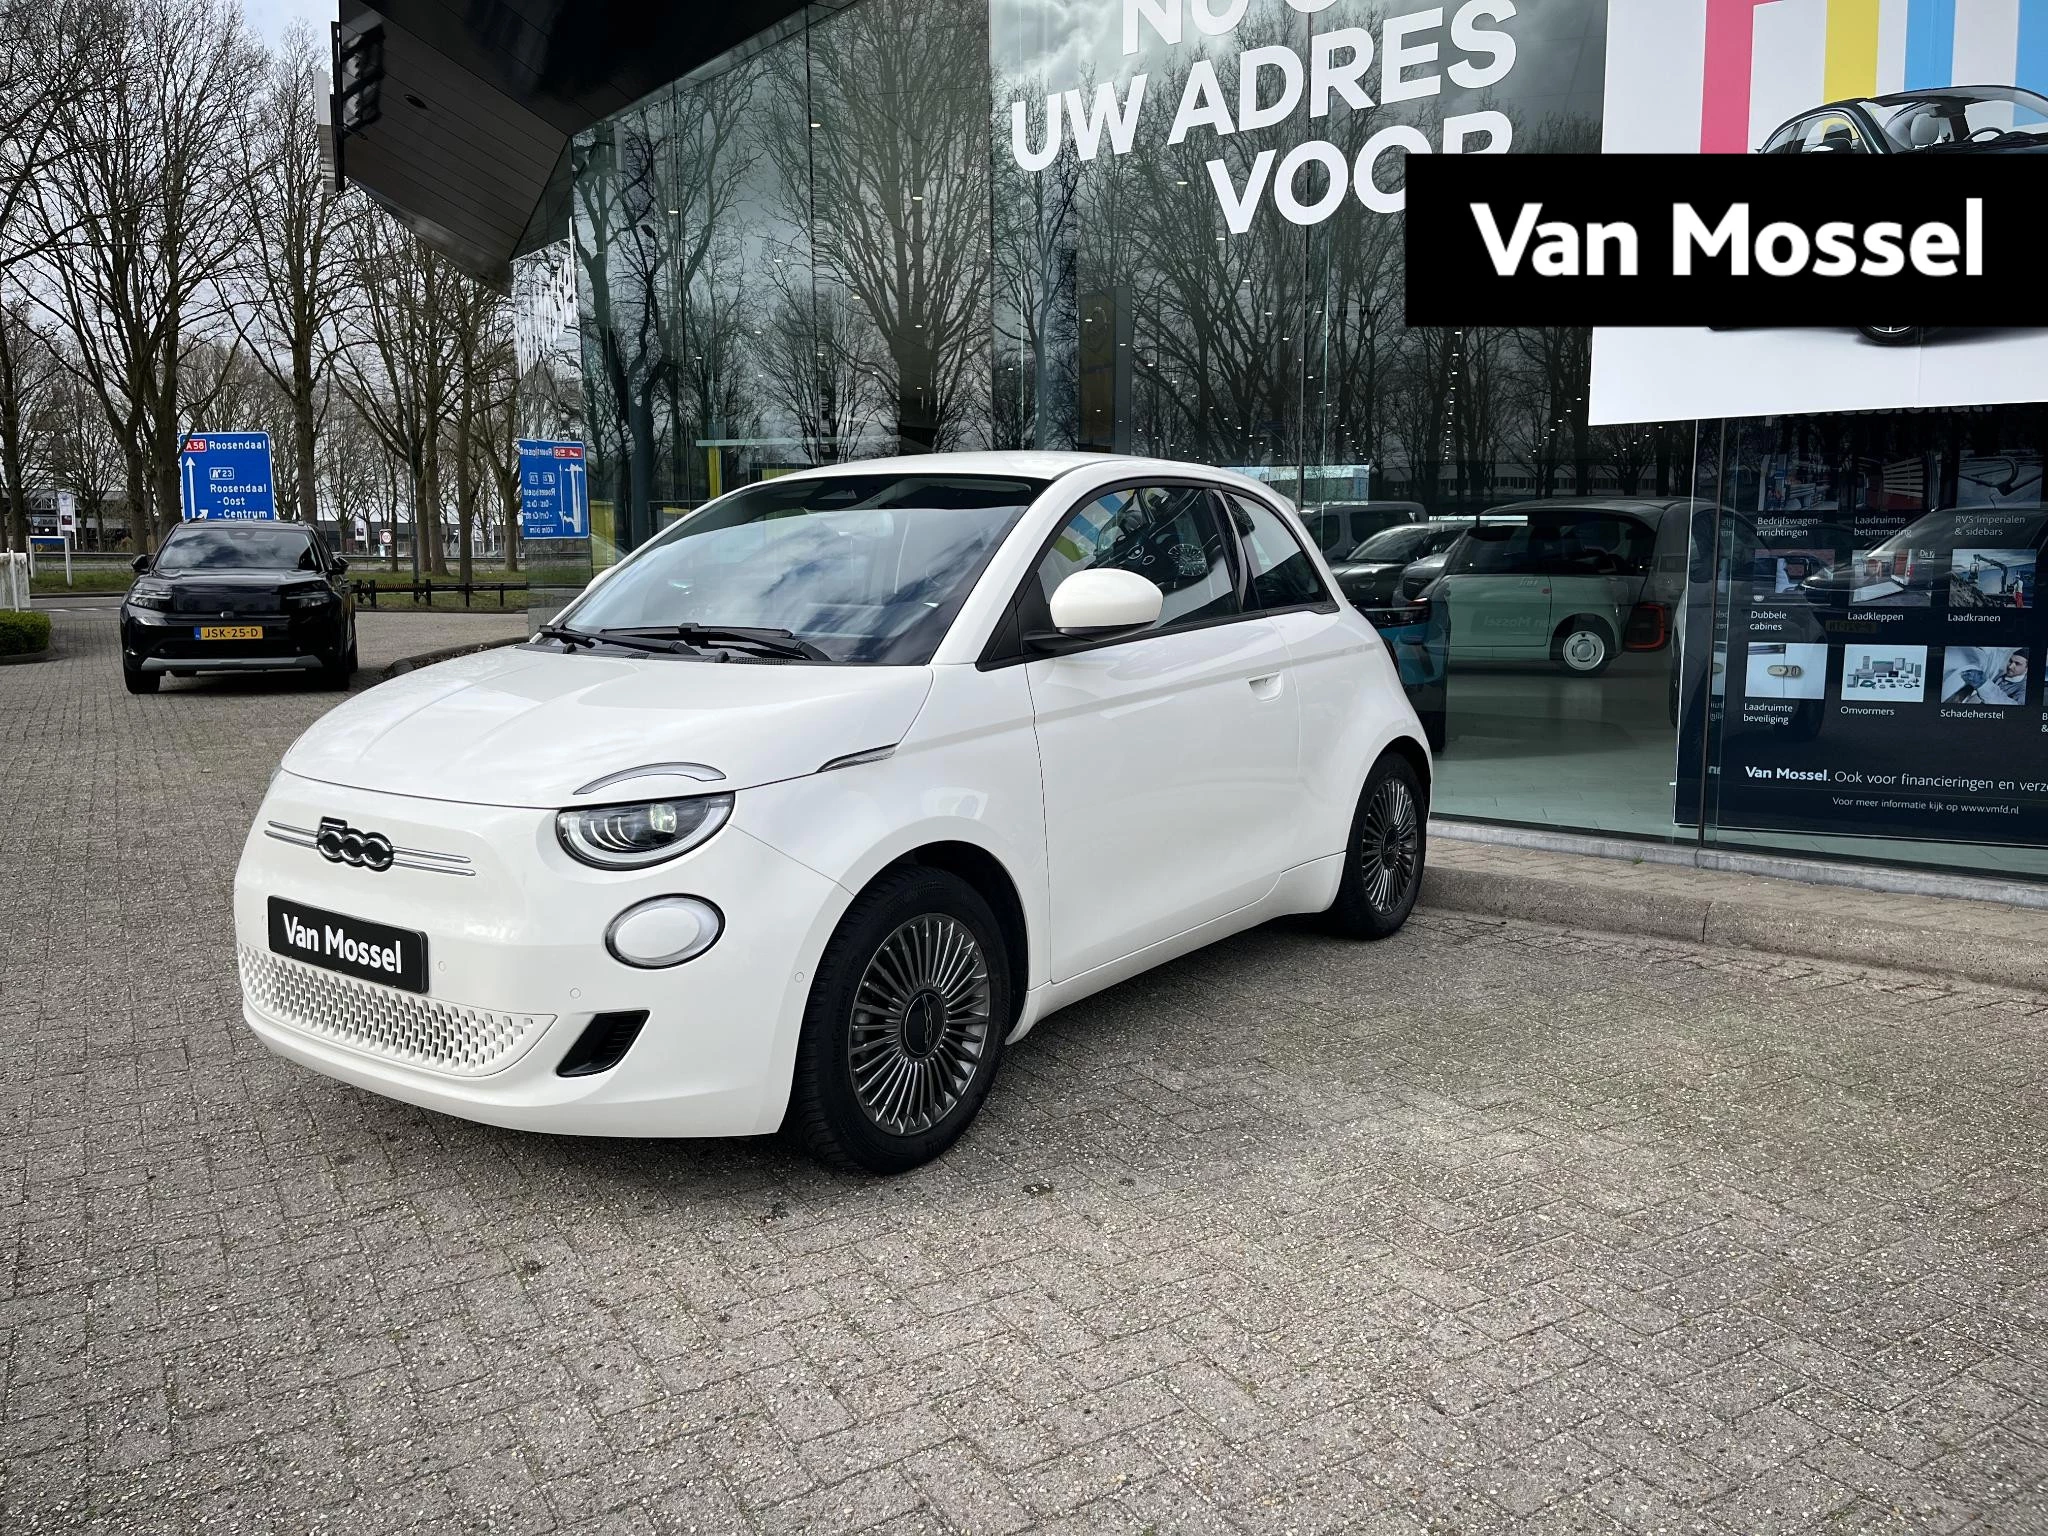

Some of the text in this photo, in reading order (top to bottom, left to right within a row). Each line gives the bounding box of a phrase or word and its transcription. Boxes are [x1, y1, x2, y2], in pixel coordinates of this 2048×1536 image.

[1012, 0, 1518, 172] UW ADRES
[185, 441, 266, 450] A58 Roosendaal
[210, 484, 267, 493] Roosendaal
[1757, 516, 1822, 528] Bedrijfswagen-
[1855, 515, 1906, 525] Laadruimte
[1955, 515, 1973, 523] RVS
[1756, 528, 1808, 538] inrichtingen
[1854, 527, 1912, 538] betimmering
[1954, 527, 2003, 537] & sidebars
[1751, 610, 1787, 620] Dubbele
[1848, 612, 1904, 624] Laadkleppen
[1948, 613, 2000, 622] Laadkranen
[1750, 622, 1782, 631] cabines
[205, 628, 258, 638] JSK-25-D
[1744, 703, 1793, 713] Laadruimte
[1840, 706, 1895, 716] Omvormers
[1940, 709, 2004, 720] Schadeherstel
[1743, 714, 1789, 726] beveiliging
[1745, 766, 1772, 779] Van
[1776, 768, 1831, 782] Mossel.
[1835, 771, 1862, 783] Ook
[1866, 775, 1896, 785] voor
[1901, 773, 1994, 792] financieringen
[1998, 780, 2014, 790] en
[1832, 797, 1853, 806] Voor
[1882, 799, 1926, 809] informatie
[1929, 802, 1943, 812] kijk
[1946, 805, 1958, 813] op
[1961, 804, 2019, 815] www.vmfd.nl
[282, 912, 402, 974] Van Mossel
